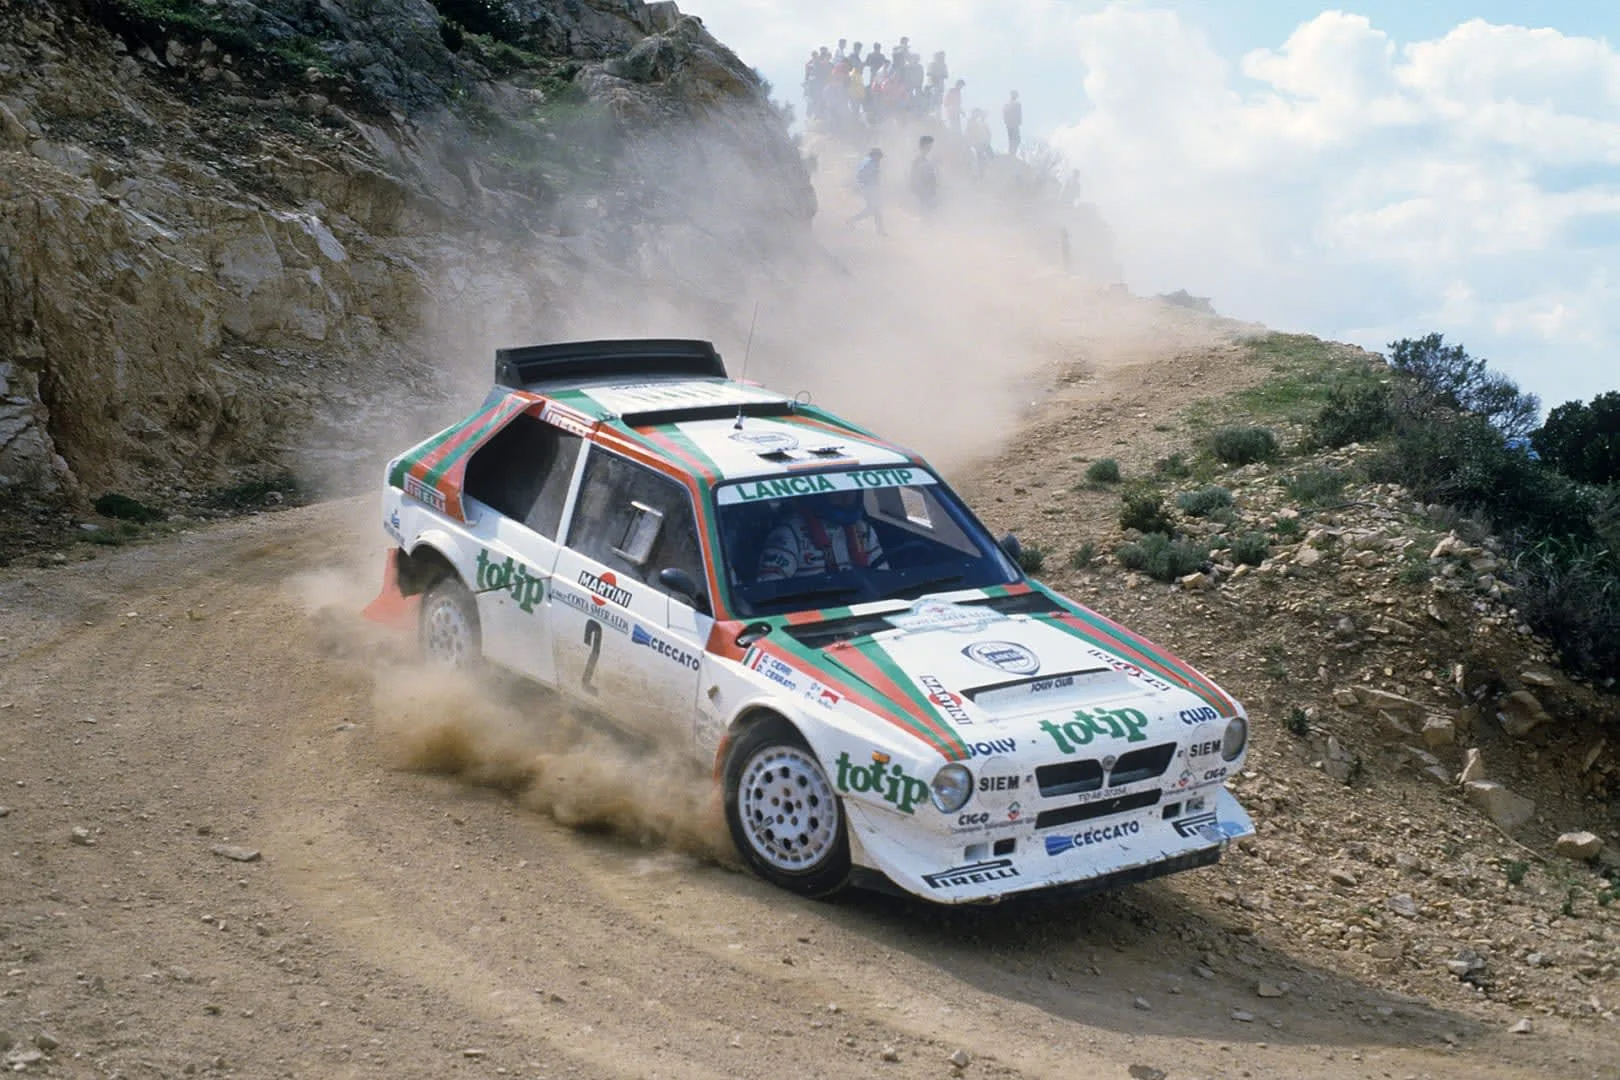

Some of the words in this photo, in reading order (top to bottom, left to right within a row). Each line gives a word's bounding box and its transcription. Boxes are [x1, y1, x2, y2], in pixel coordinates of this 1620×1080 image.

[736, 475, 836, 501] LANCIA
[847, 469, 914, 488] TOTIP
[476, 548, 545, 615] totip
[577, 570, 633, 608] MARTINI
[567, 591, 590, 611] COSTA
[582, 619, 603, 697] 2
[650, 637, 701, 671] CECCATO
[1055, 676, 1075, 689] CLUB
[920, 675, 973, 725] MARTINI
[969, 738, 1017, 757] JOLLY
[1179, 706, 1218, 725] CLUB
[1037, 706, 1149, 755] totip
[1189, 740, 1222, 758] SIEM
[835, 751, 930, 816] totip
[978, 775, 1021, 792] SIEM
[1203, 766, 1228, 781] CIGO
[957, 812, 990, 826] CIGO
[1073, 820, 1140, 847] CECCATO
[921, 858, 1020, 889] PIRELLI
